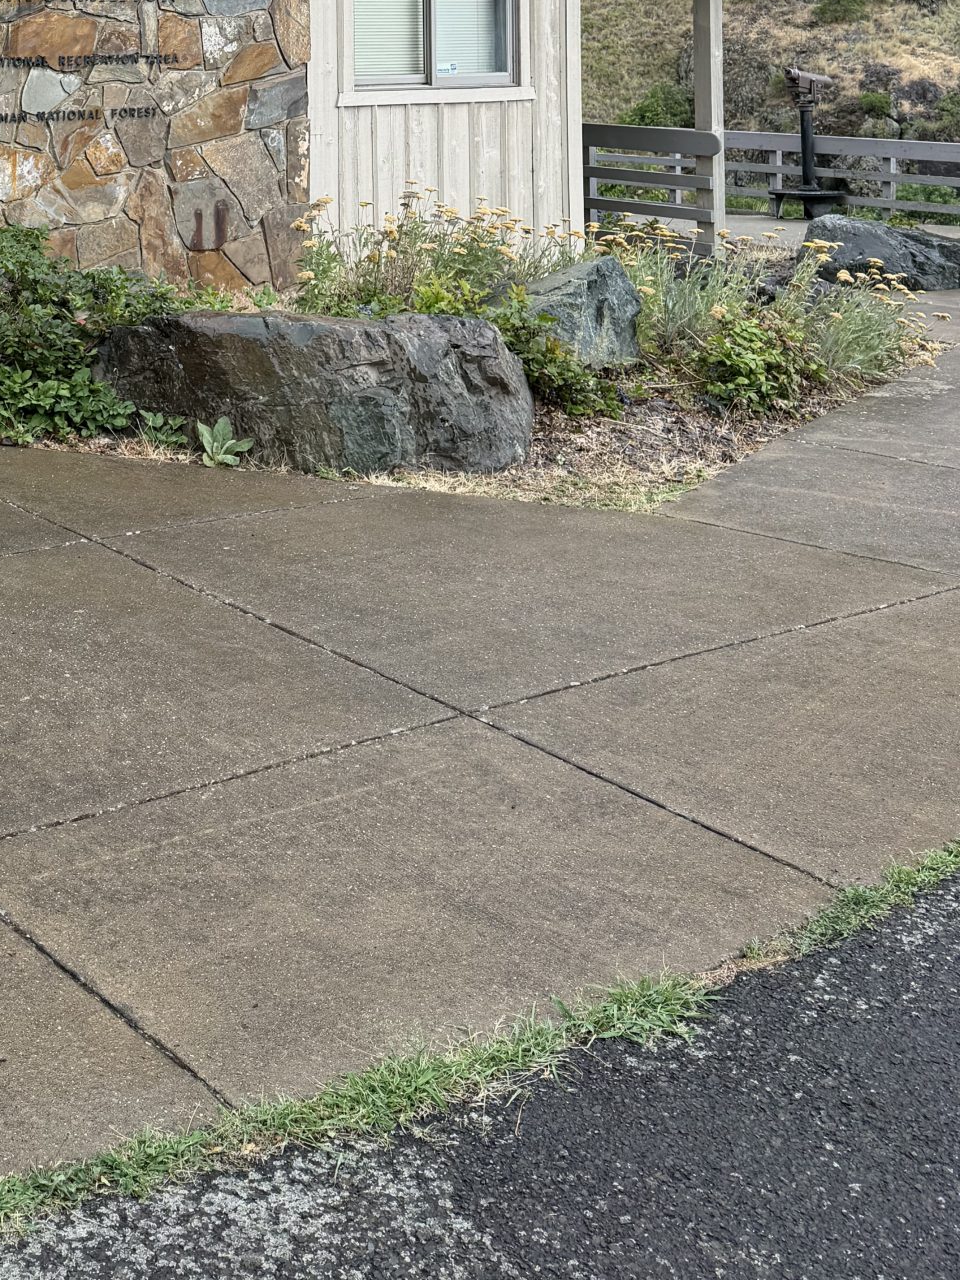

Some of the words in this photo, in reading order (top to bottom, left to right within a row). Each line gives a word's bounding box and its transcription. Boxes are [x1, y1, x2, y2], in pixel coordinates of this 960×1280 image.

[58, 53, 140, 68] RECREATION
[147, 53, 179, 65] AREA
[36, 108, 103, 122] NATIONAL
[110, 107, 157, 119] FOREST
